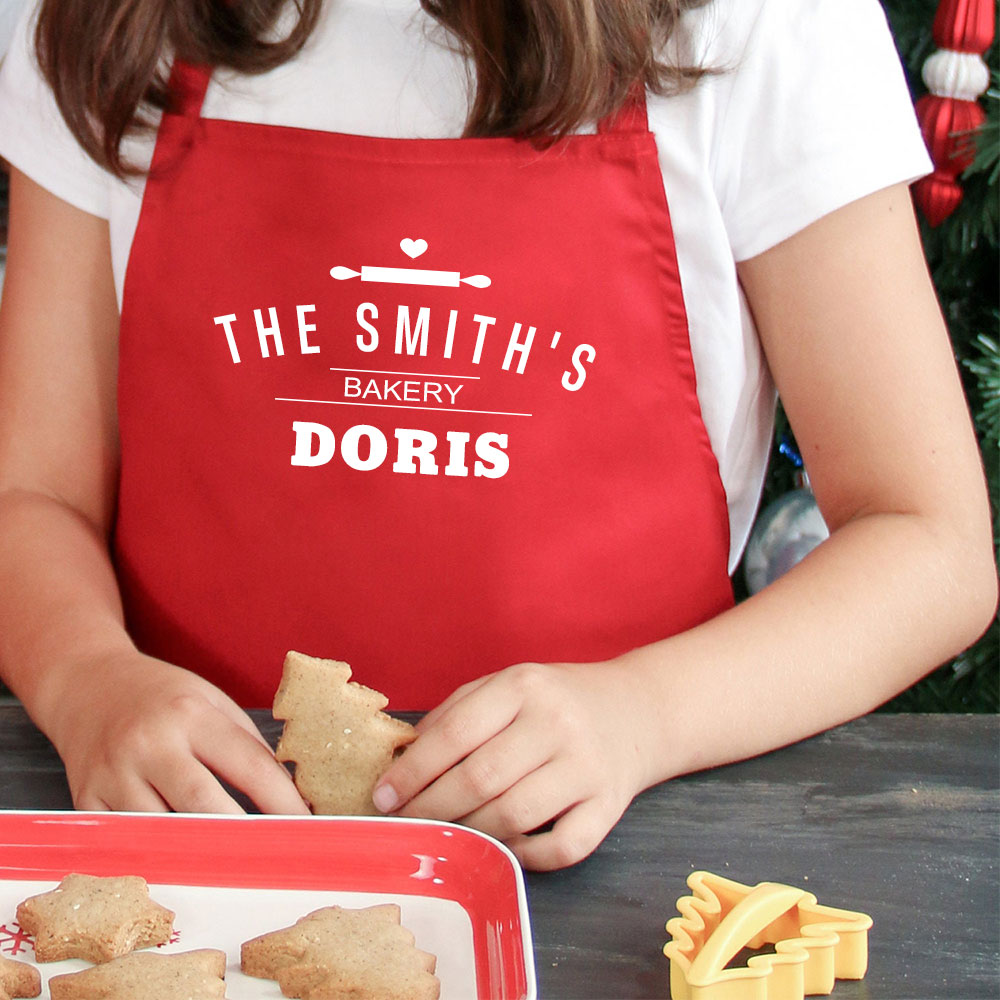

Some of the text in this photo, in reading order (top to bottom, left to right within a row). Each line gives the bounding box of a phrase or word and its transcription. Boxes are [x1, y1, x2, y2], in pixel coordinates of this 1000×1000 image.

[213, 302, 597, 392] THE SMITH'S
[344, 376, 464, 405] BAKERY
[290, 420, 510, 479] DORIS
